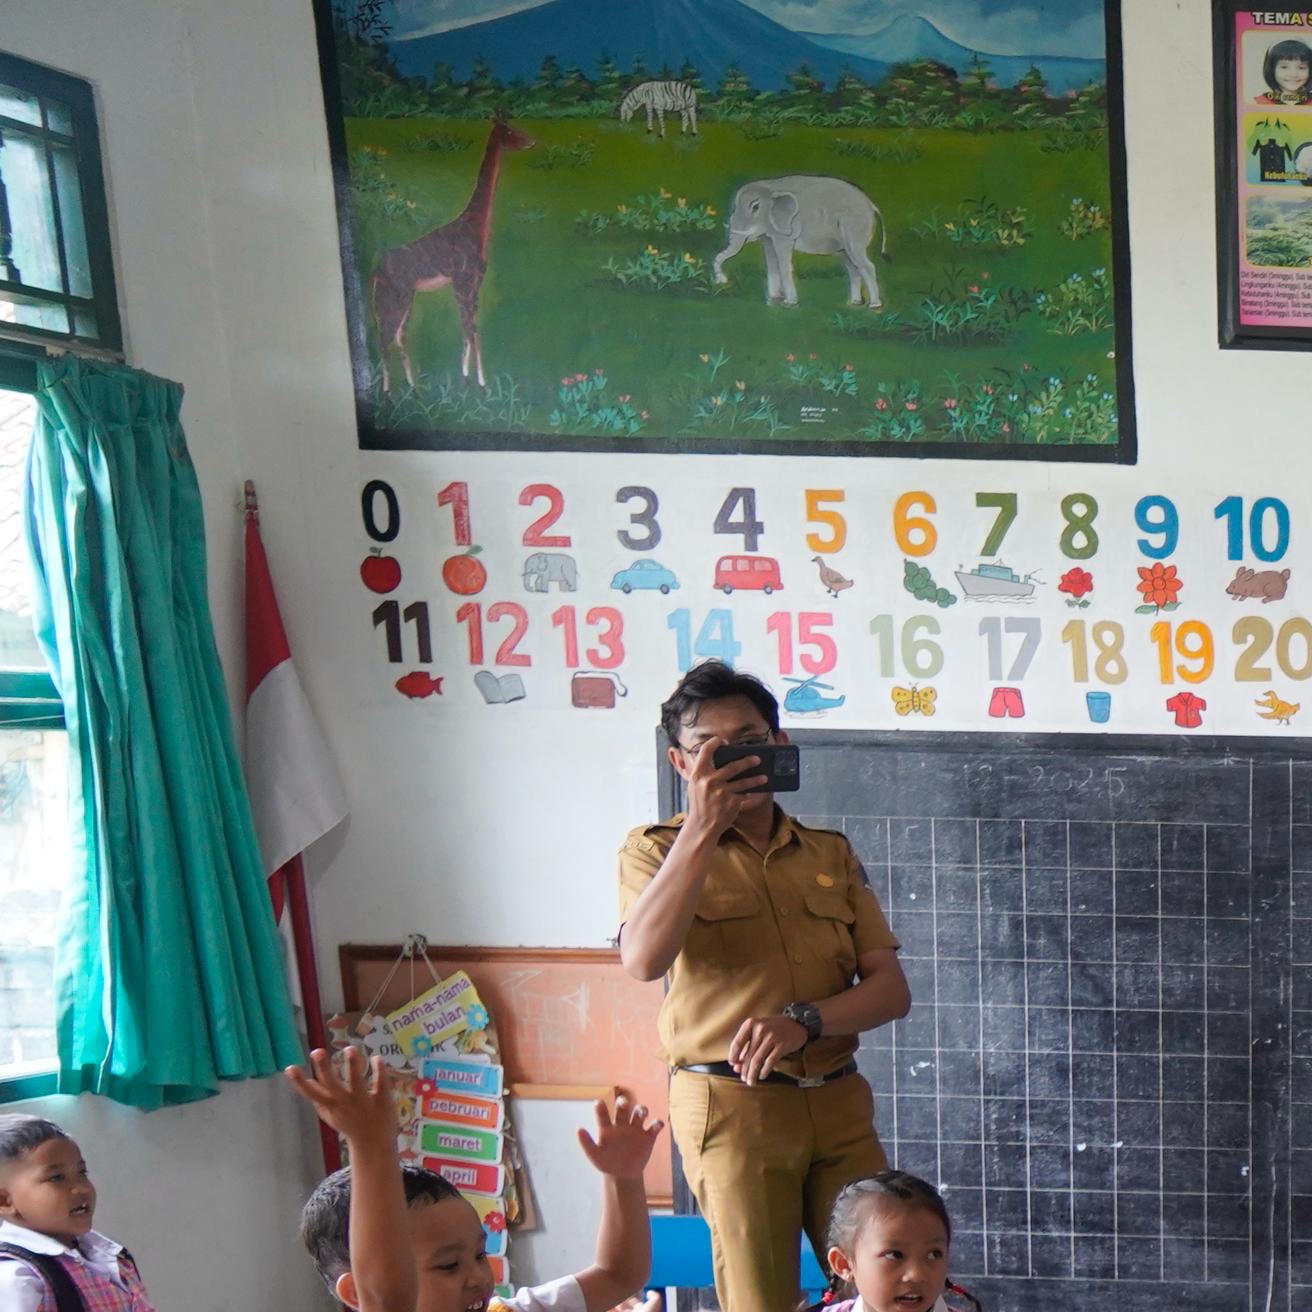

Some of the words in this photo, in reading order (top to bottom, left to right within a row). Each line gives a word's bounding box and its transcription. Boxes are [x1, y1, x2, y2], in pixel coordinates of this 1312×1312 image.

[1252, 12, 1302, 25] TEMA
[361, 479, 401, 543] 0
[437, 481, 472, 546] 1
[518, 483, 572, 547] 2
[616, 485, 663, 551] 3
[713, 487, 764, 552] 4
[805, 489, 848, 554] 5
[893, 491, 938, 557] 6
[975, 492, 1018, 557] 7
[1058, 492, 1099, 560] 8
[1134, 494, 1179, 560] 9
[1214, 495, 1290, 562] 10
[372, 600, 433, 664] 11
[456, 601, 532, 667] 12
[552, 604, 626, 670] 13
[667, 607, 742, 672] 14
[766, 610, 838, 675] 15
[869, 613, 945, 678] 16
[978, 616, 1042, 681] 17
[1061, 618, 1129, 685] 18
[1150, 619, 1215, 685] 19
[392, 977, 471, 1032] nama-nama
[424, 1004, 466, 1036] bulan
[430, 1099, 490, 1120] pebruari
[438, 1132, 482, 1150] maret
[442, 1165, 476, 1187] april
